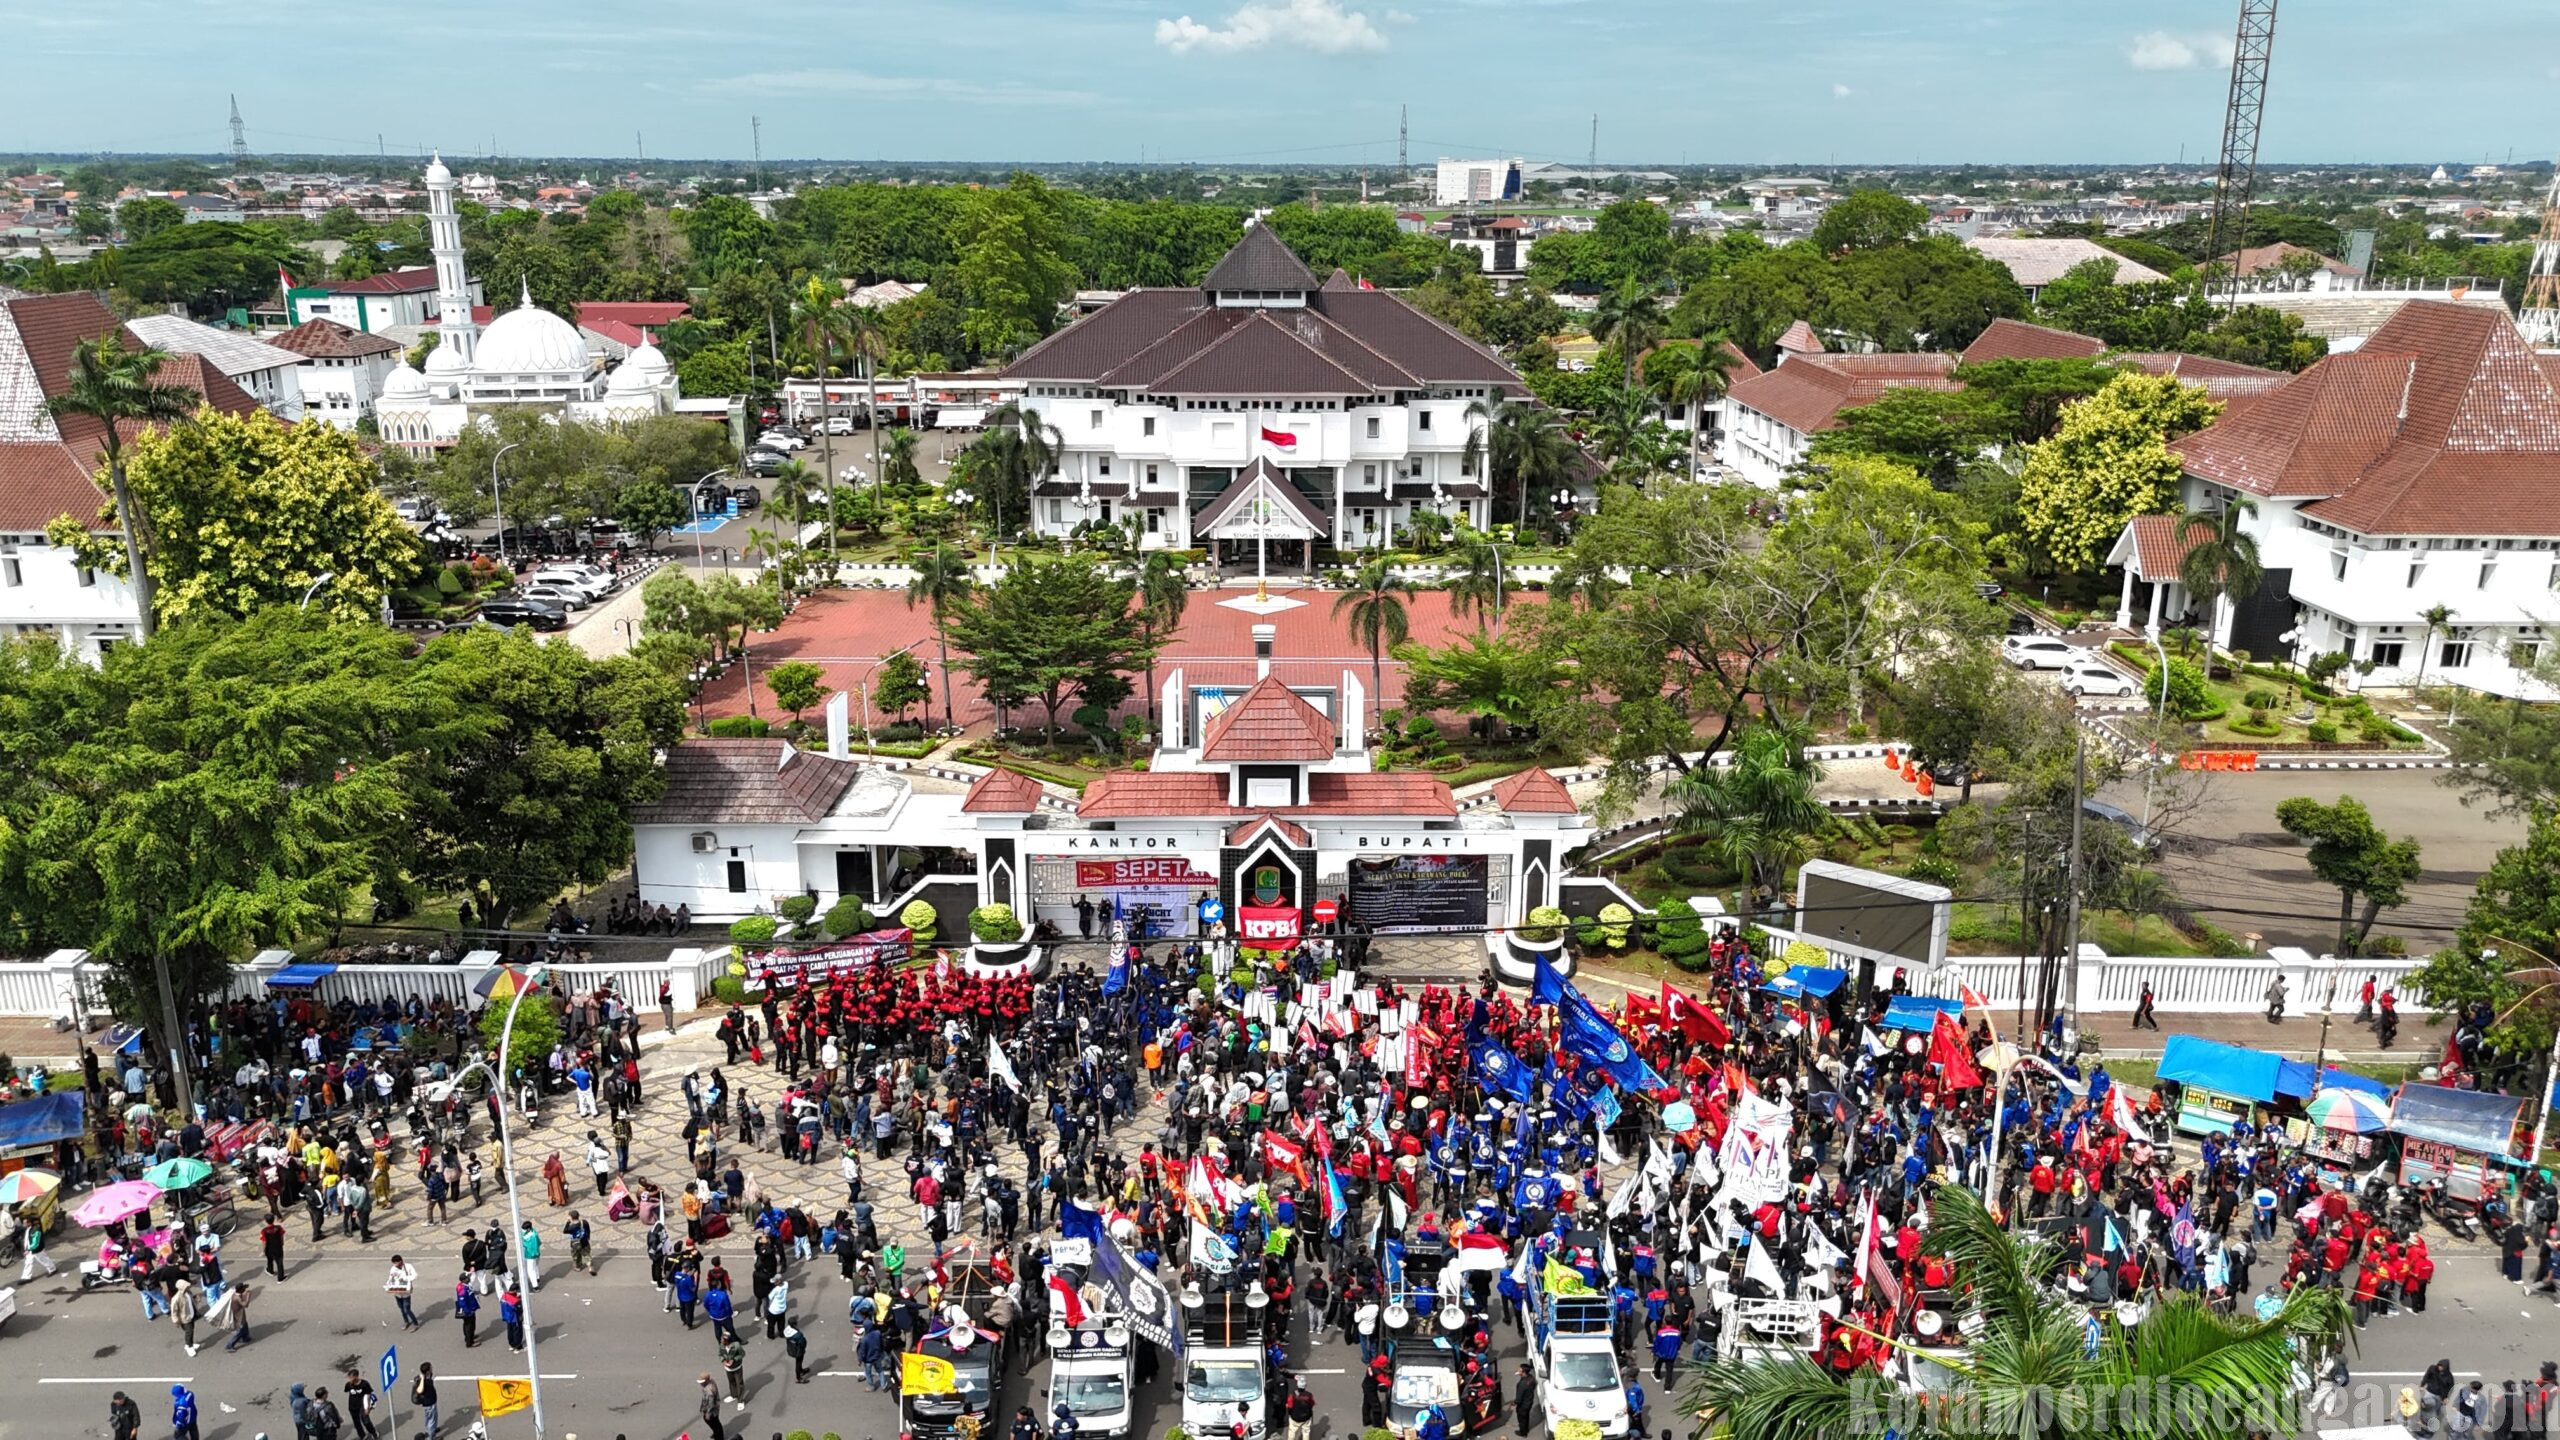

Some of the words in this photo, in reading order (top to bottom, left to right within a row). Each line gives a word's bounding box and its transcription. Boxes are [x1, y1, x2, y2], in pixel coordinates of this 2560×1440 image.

[1069, 837, 1177, 848] KANTOR
[1359, 837, 1468, 847] BUPATI
[1115, 859, 1209, 877] SEPETA
[798, 953, 824, 963] PANGKAL
[824, 947, 864, 960] PERJUANGAN
[810, 962, 829, 971] CABUT
